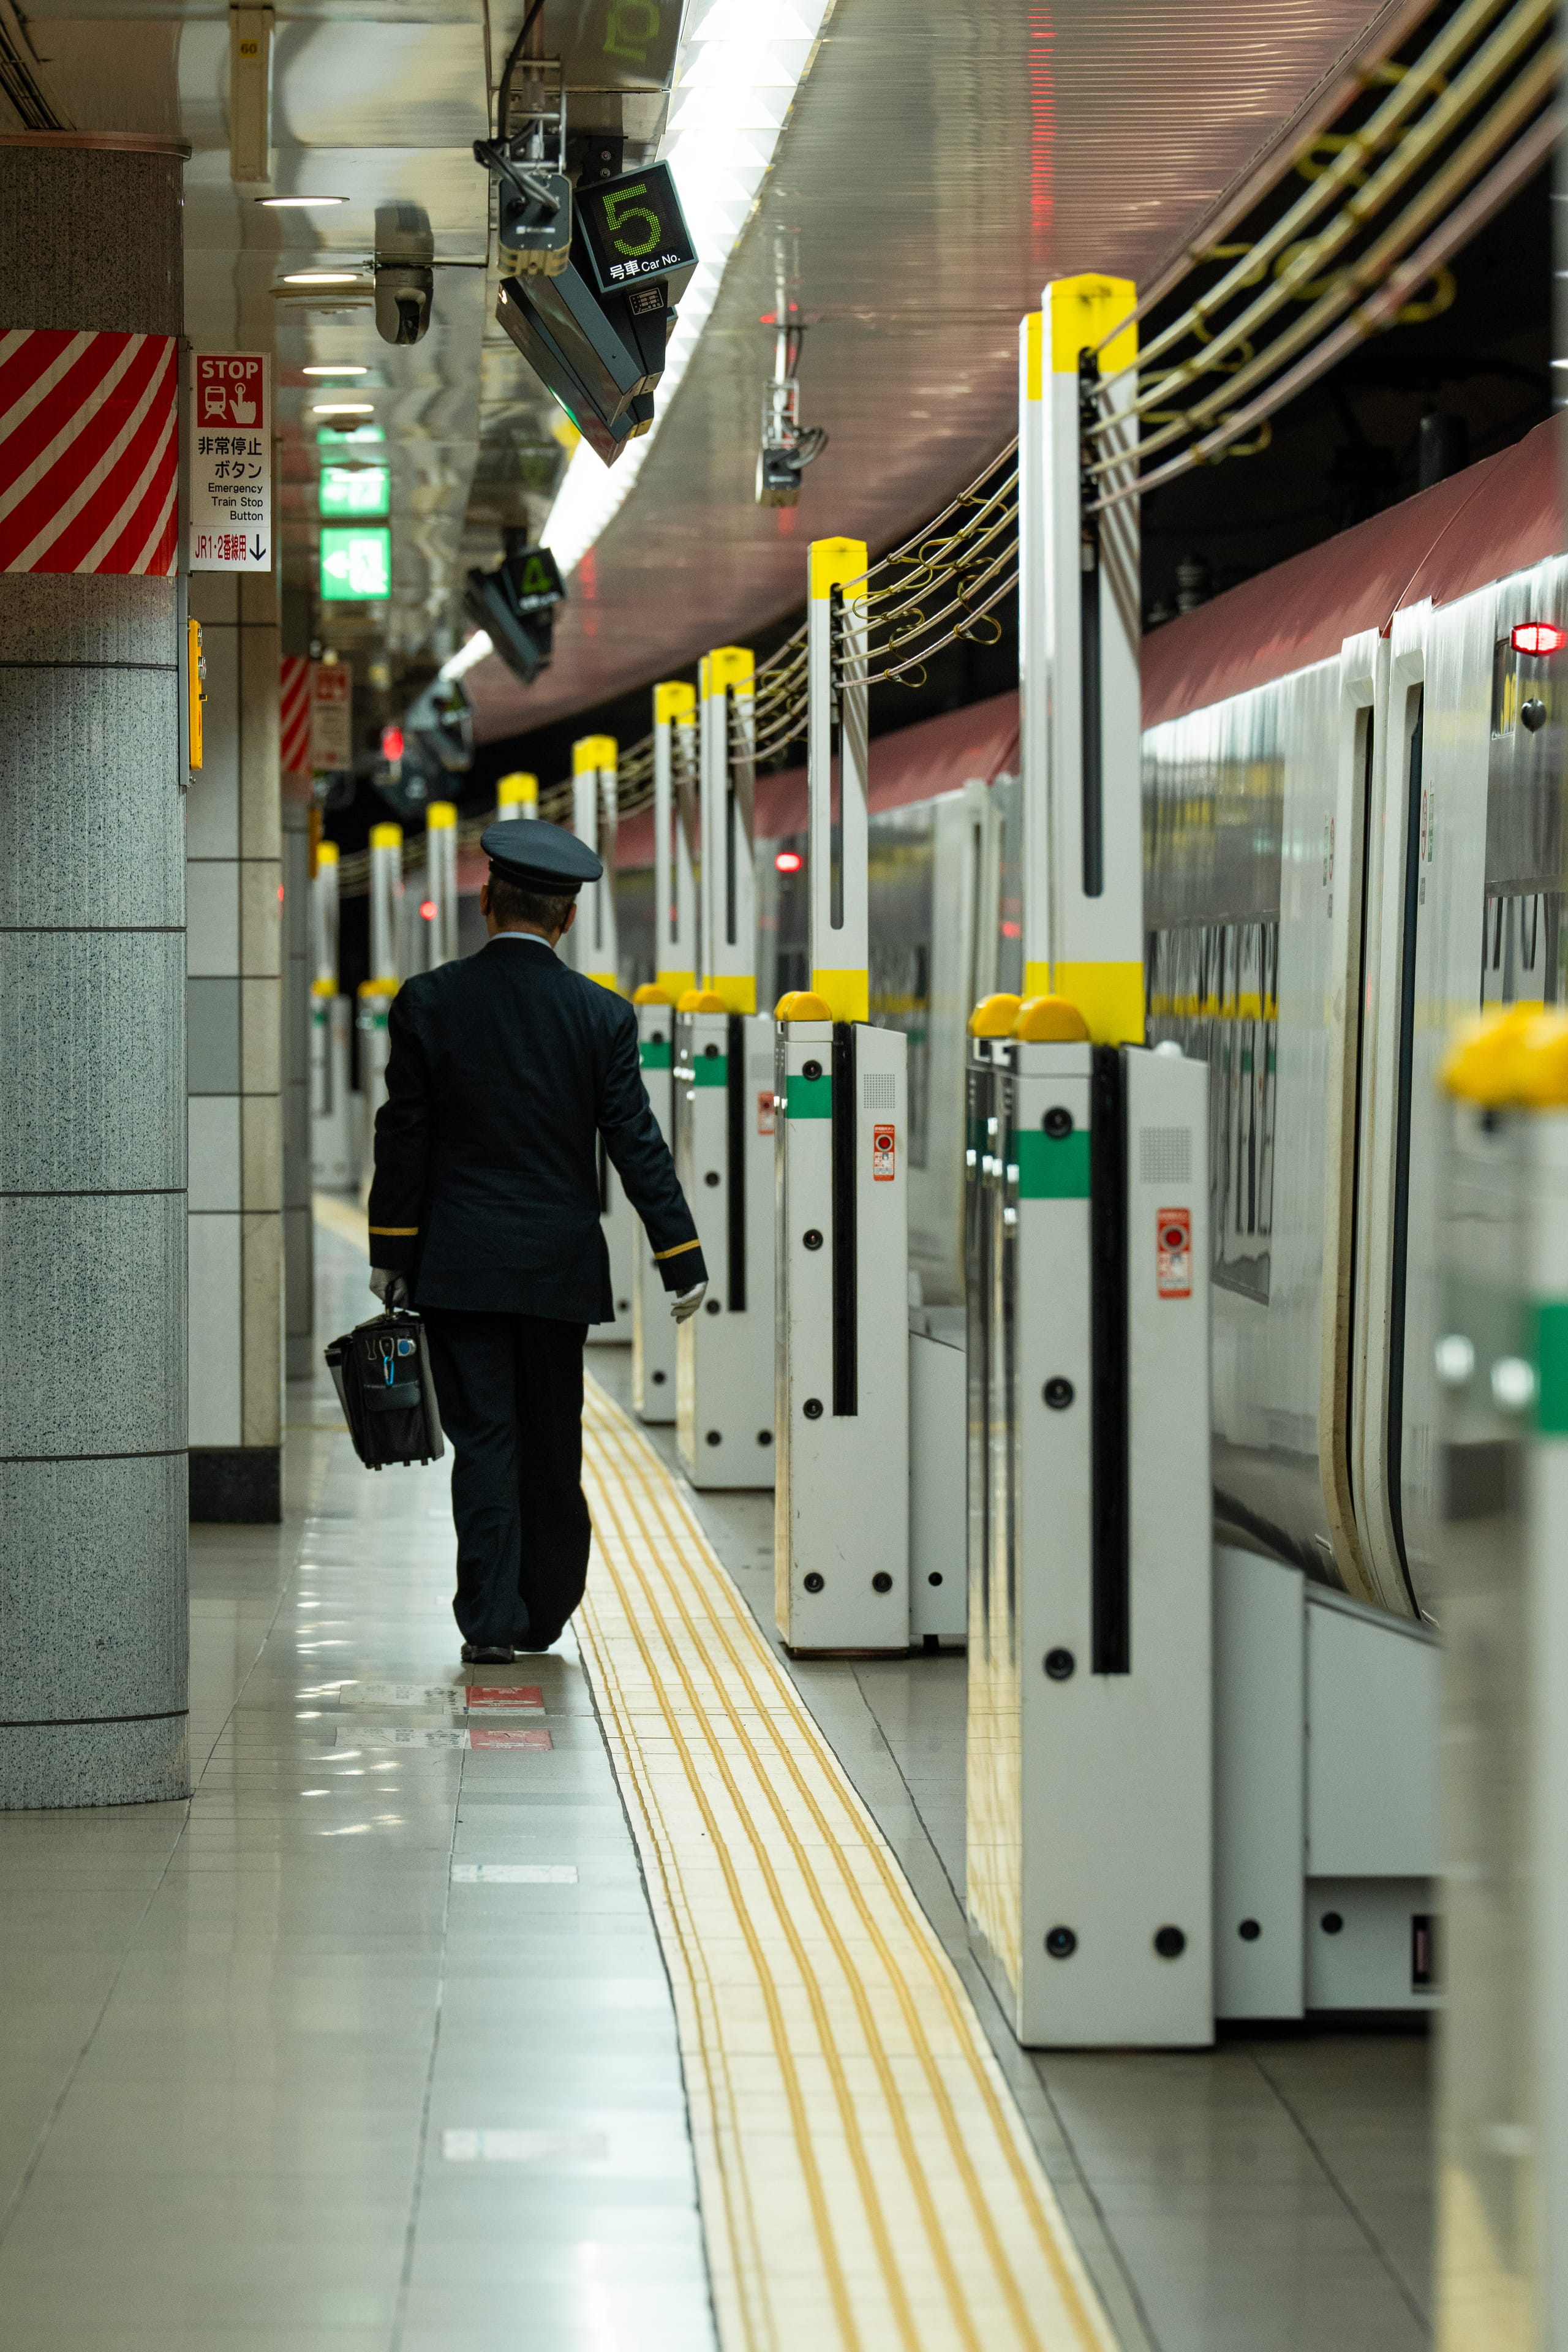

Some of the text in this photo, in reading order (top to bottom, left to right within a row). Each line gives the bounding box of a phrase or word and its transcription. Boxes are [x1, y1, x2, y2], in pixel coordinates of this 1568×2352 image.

[602, 184, 661, 257] 5
[610, 254, 680, 280] 号車 Car No.
[202, 360, 258, 379] STOP
[198, 436, 263, 456] 非常停止
[215, 460, 262, 478] ボタン
[208, 483, 263, 494] Emergency
[211, 496, 263, 508] Train Stop
[230, 510, 263, 521] Button
